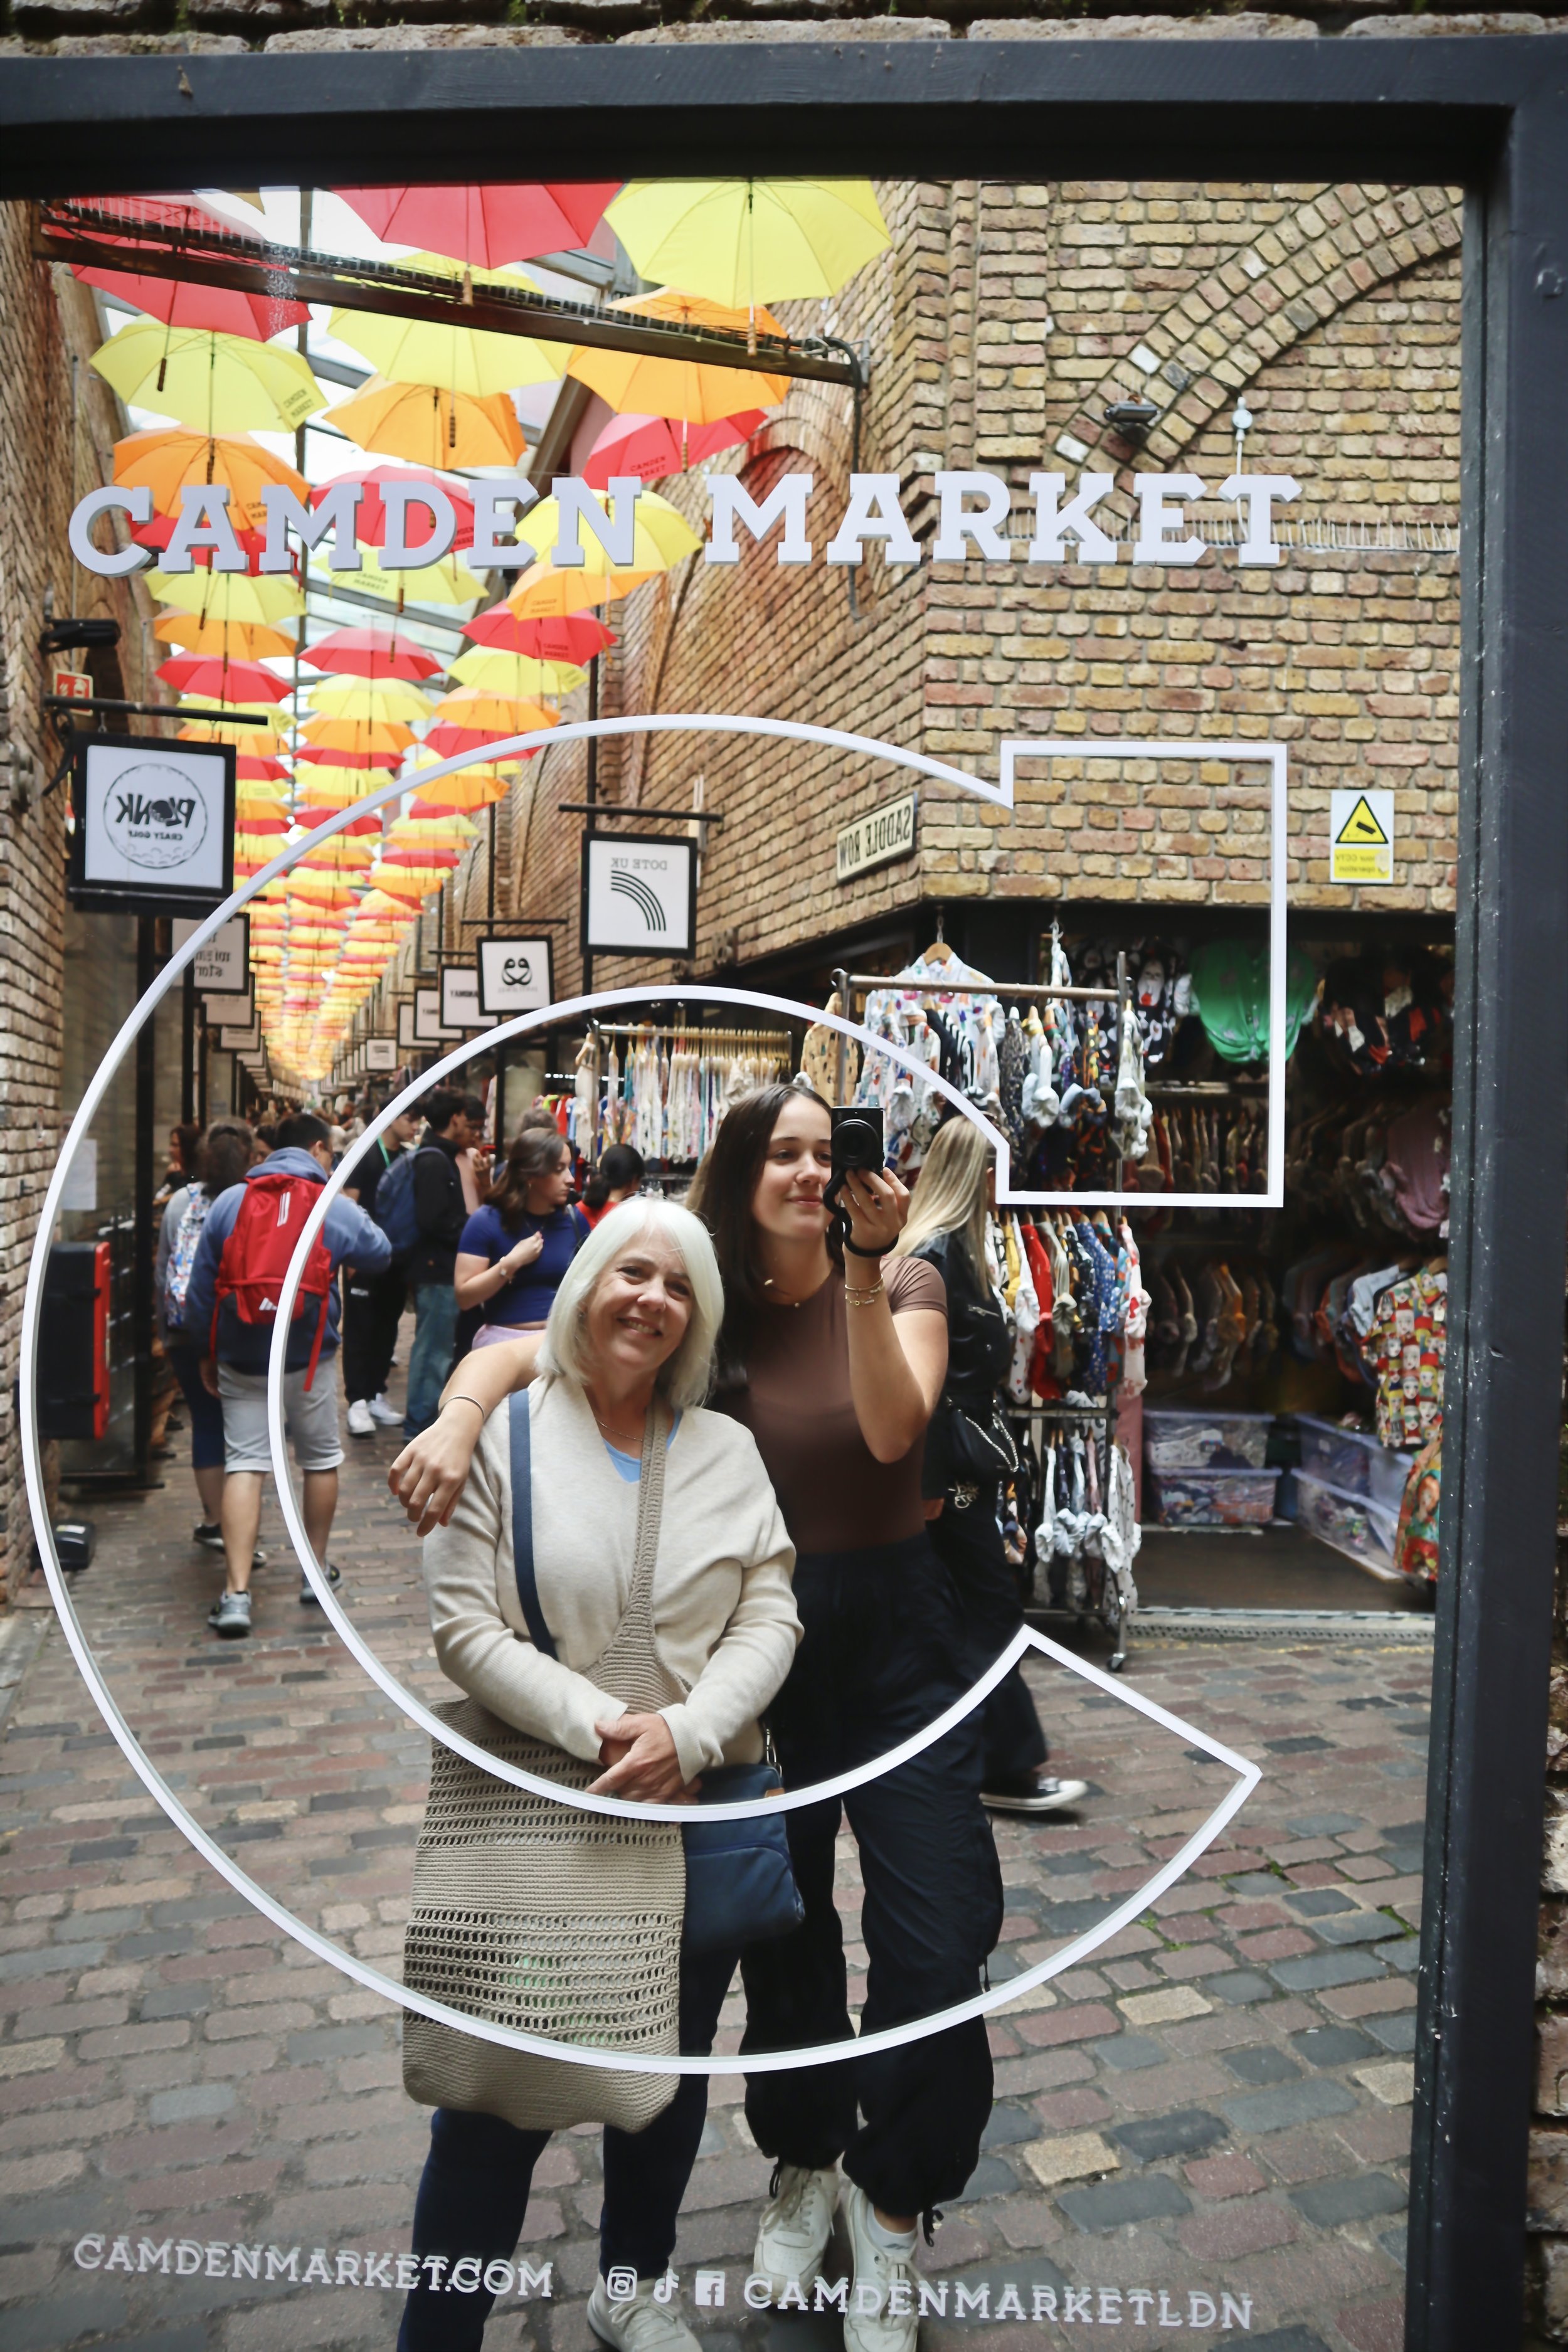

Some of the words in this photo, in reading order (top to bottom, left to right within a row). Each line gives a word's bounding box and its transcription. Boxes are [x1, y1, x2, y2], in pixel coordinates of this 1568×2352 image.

[630, 455, 666, 472] CAMDEN
[68, 475, 642, 577] CAMDEN
[704, 471, 1303, 568] MARKET
[74, 2237, 553, 2298] CAMDENMARKET.COM
[744, 2277, 1253, 2330] CAMDENMARKETLDN
